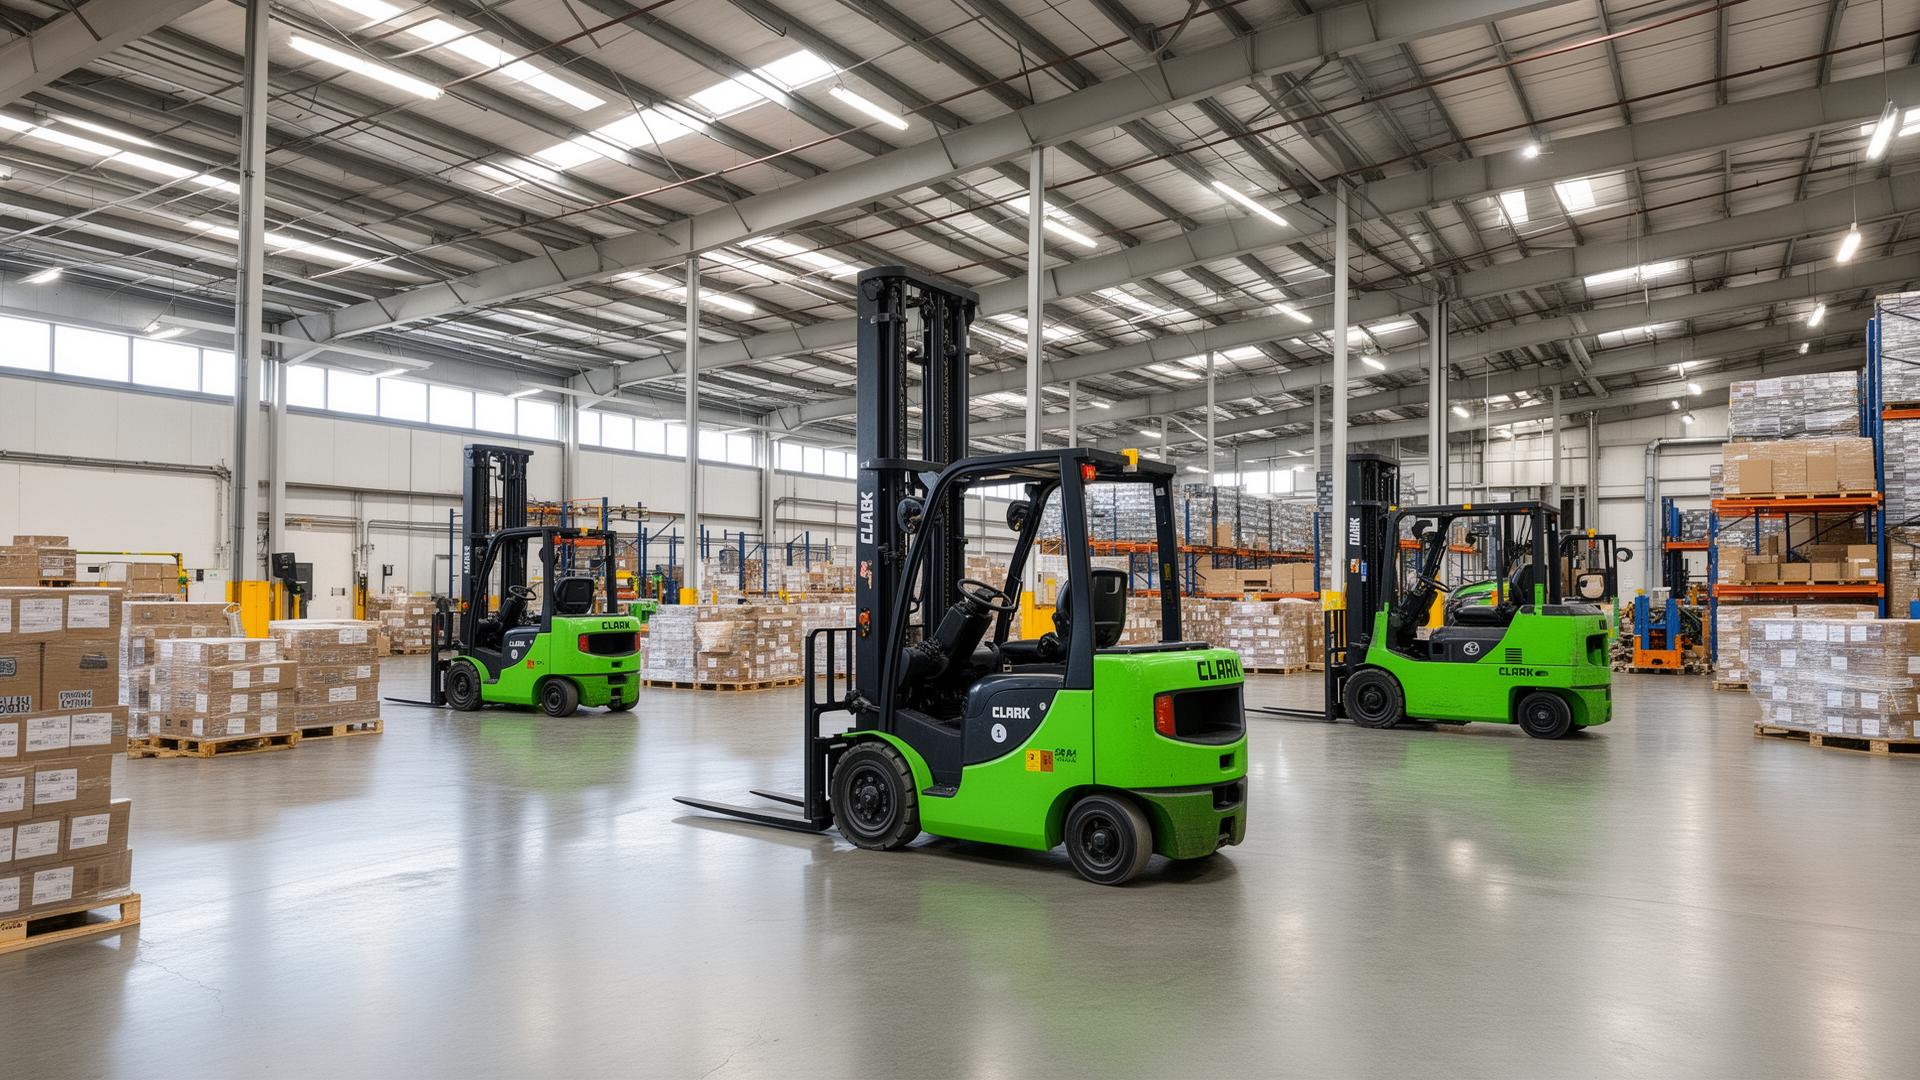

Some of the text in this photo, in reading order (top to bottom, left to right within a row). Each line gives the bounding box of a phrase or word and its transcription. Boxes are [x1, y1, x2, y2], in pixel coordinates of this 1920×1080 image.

[602, 621, 630, 630] CLARK
[1196, 658, 1240, 680] CLARK
[1498, 667, 1534, 677] CLARK
[992, 706, 1031, 719] CLARK
